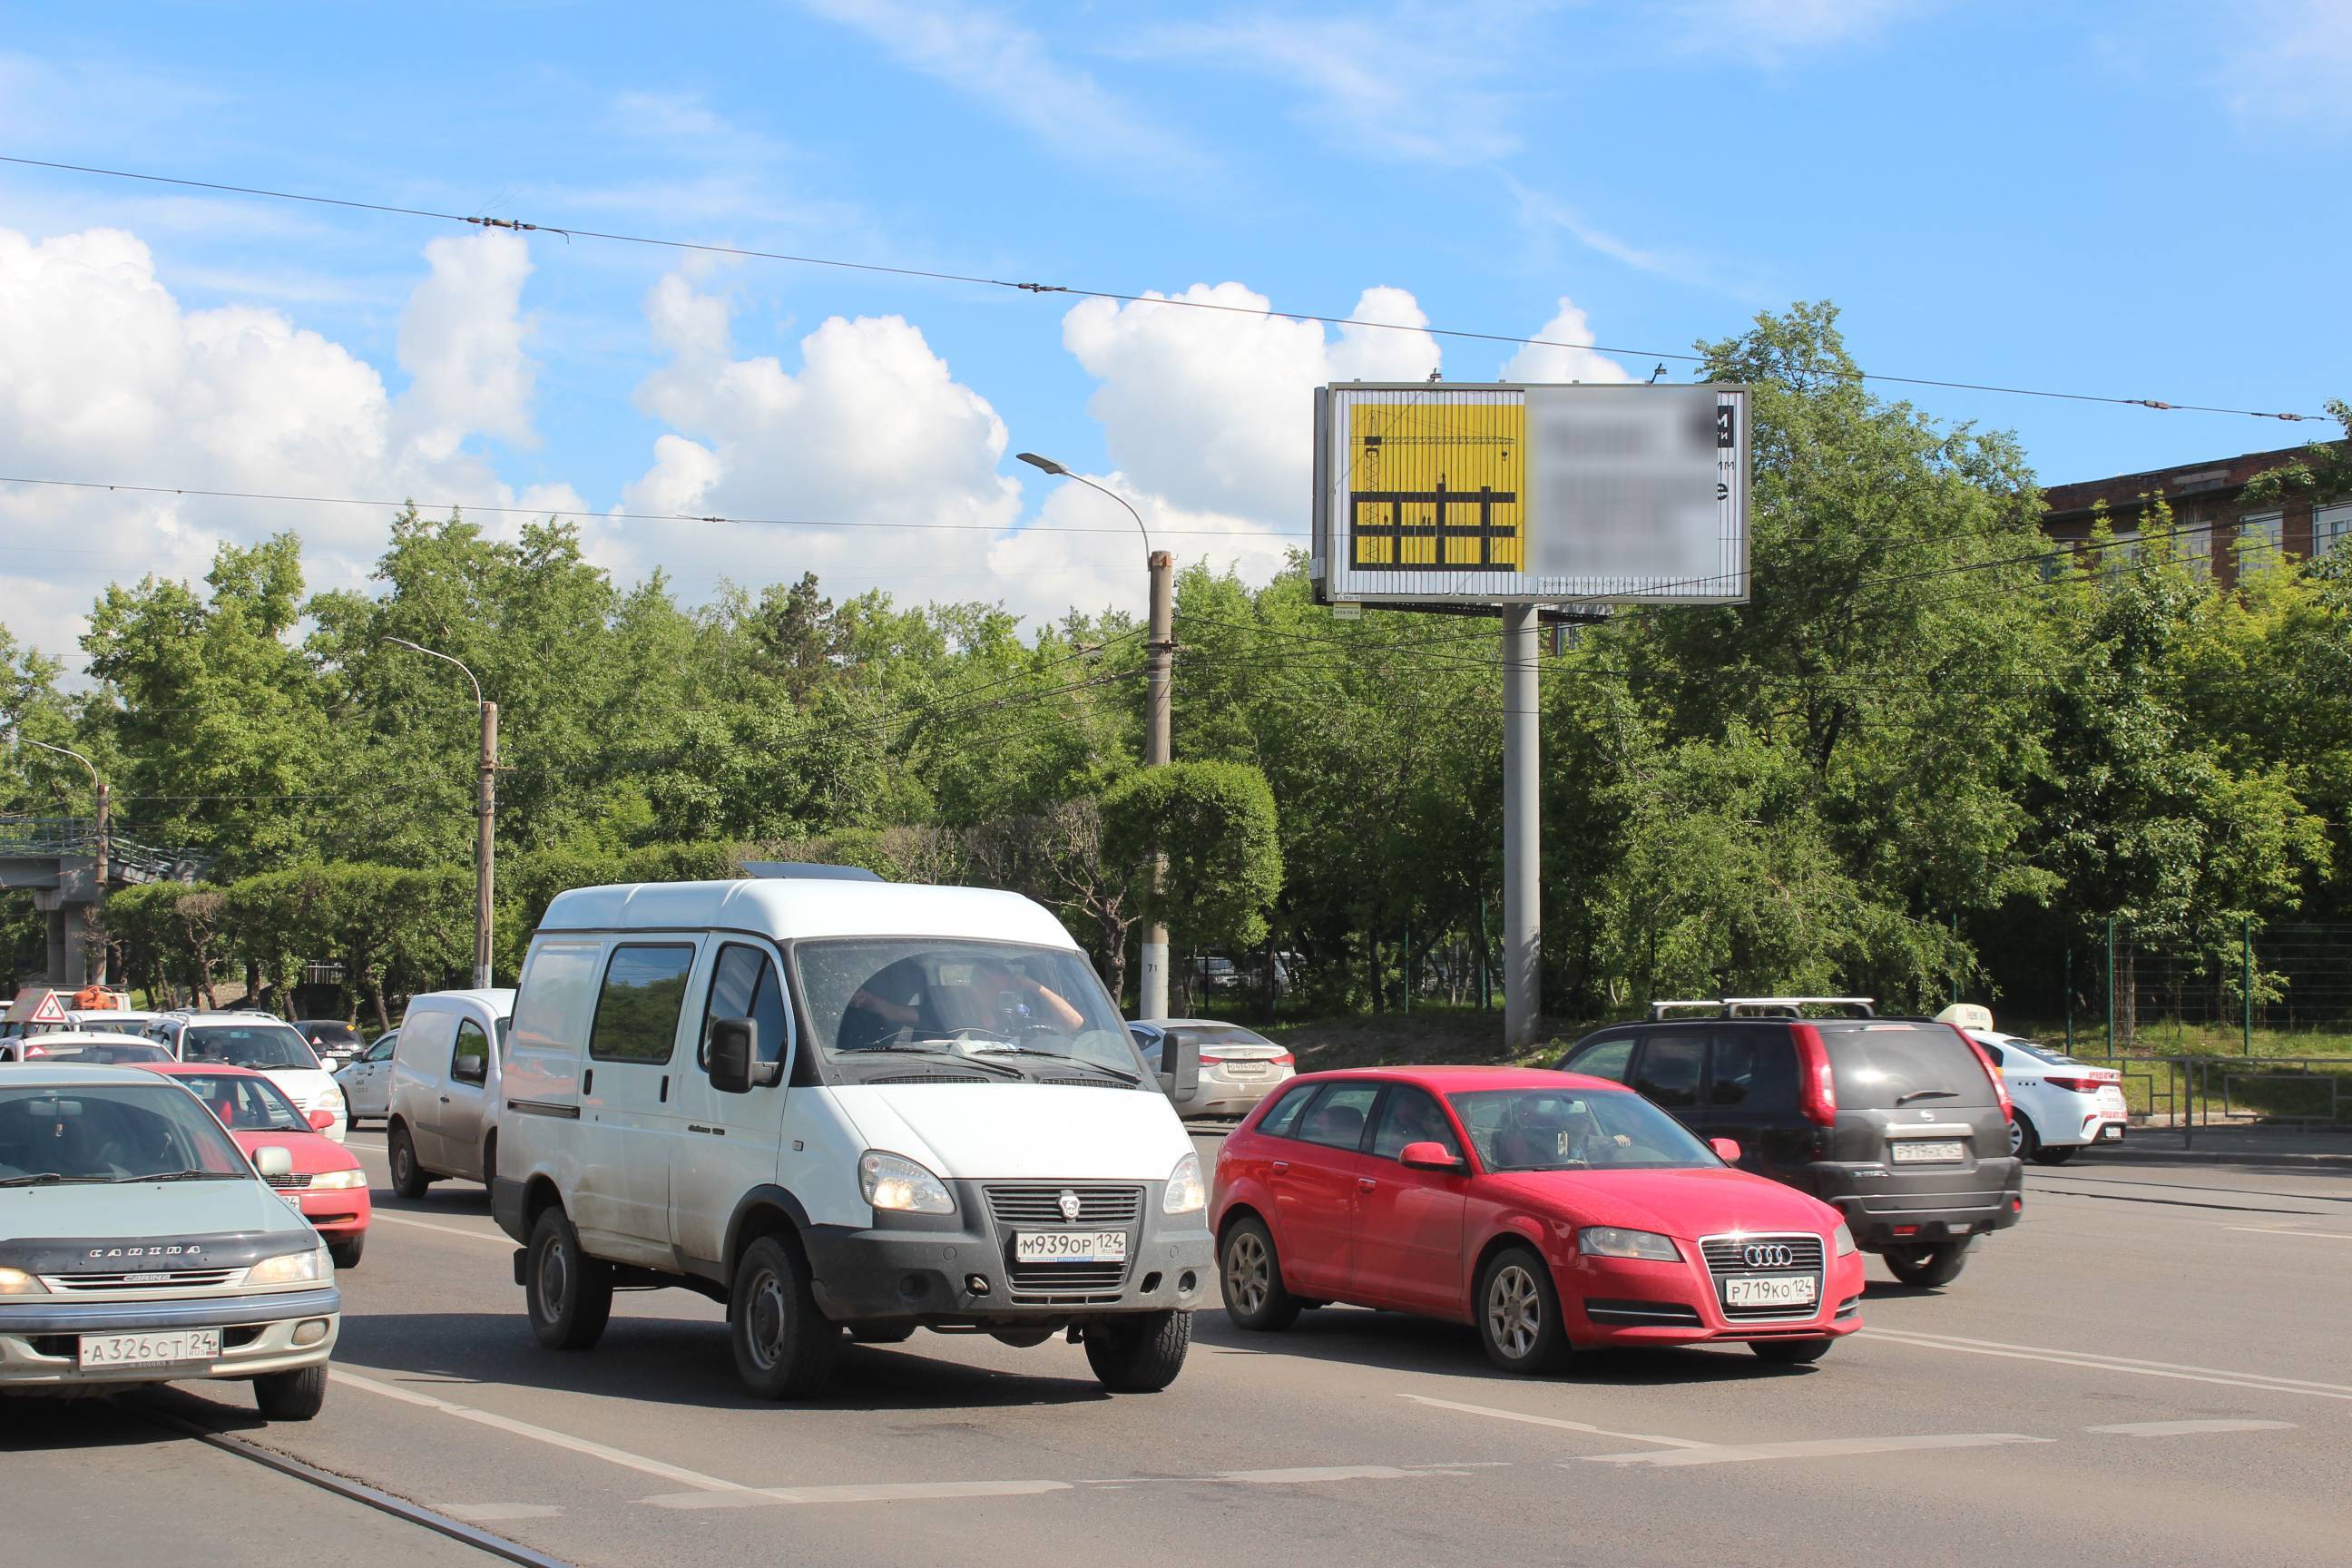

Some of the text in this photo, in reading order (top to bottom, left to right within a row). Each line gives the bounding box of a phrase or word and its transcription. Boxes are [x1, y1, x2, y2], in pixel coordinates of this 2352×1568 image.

[1148, 964, 1158, 973] 71
[1023, 1233, 1122, 1254] М939ОР 124
[123, 1274, 171, 1282] CARINA
[1731, 1279, 1811, 1299] Р719КО 124
[92, 1331, 213, 1362] А326СТ 24
[189, 1348, 205, 1357] RUS
